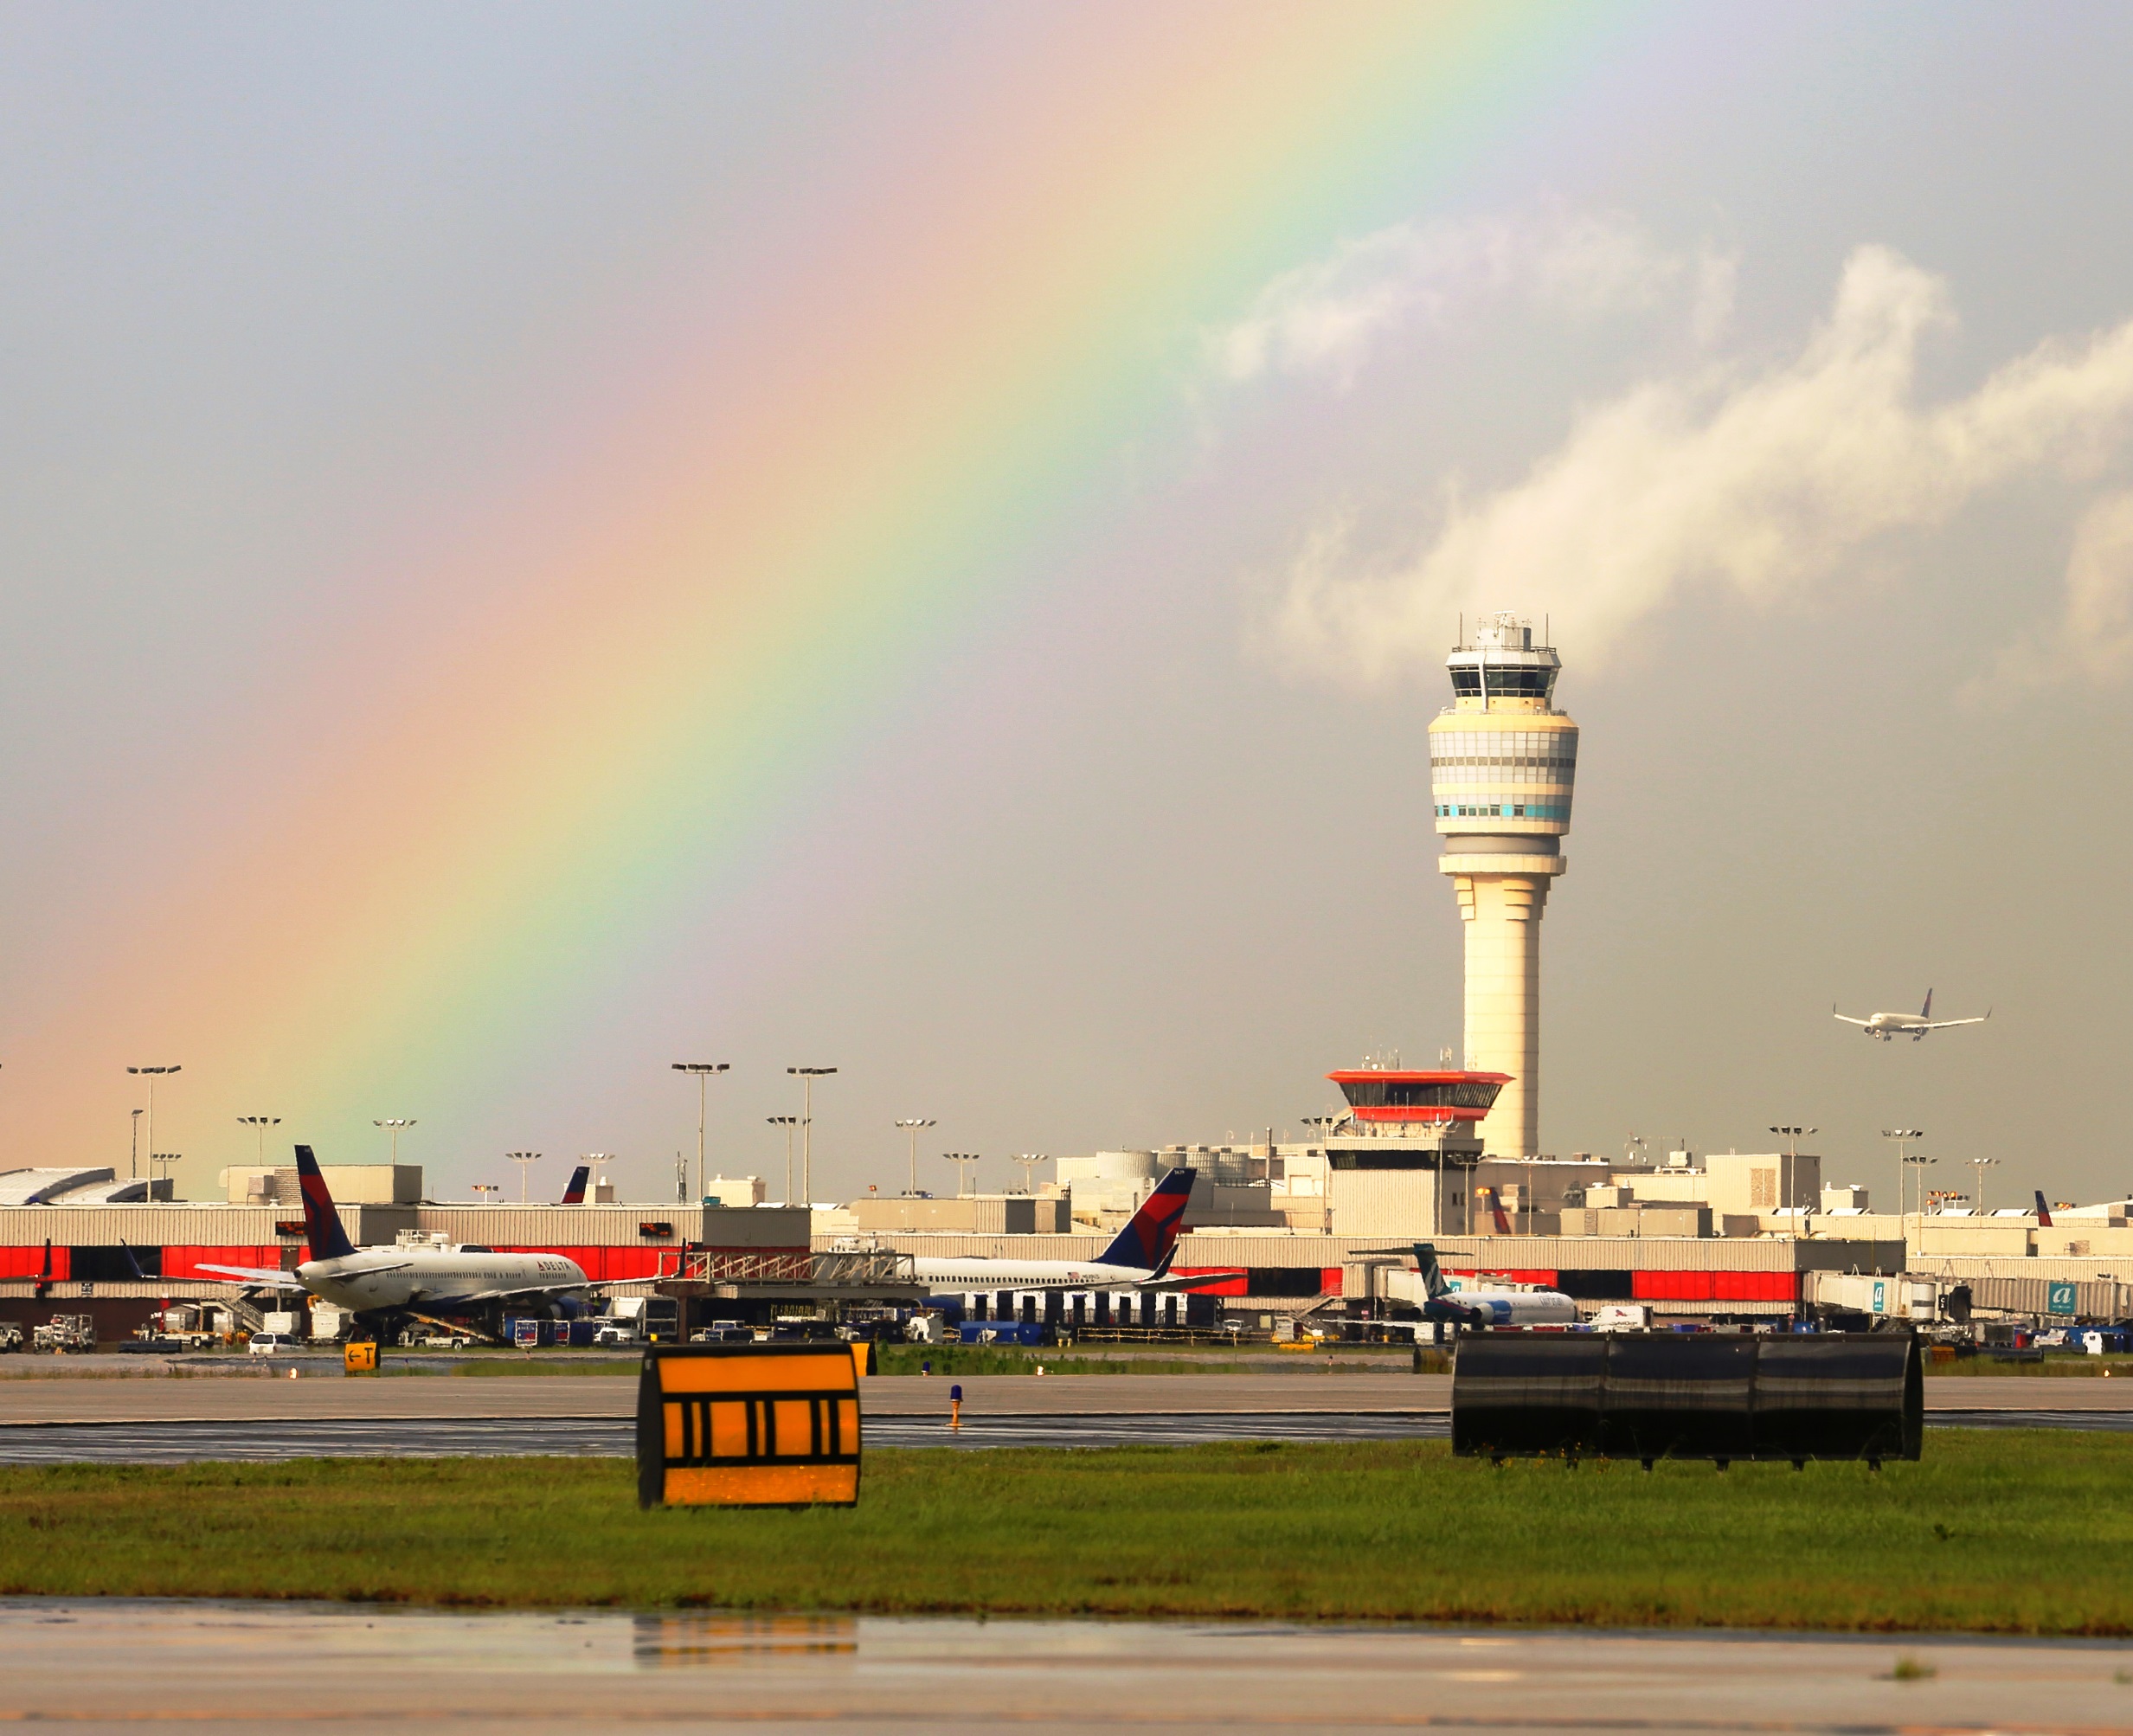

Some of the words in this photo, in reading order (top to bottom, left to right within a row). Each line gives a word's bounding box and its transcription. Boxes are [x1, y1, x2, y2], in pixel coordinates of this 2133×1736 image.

[543, 1261, 571, 1271] DELTA
[2053, 1287, 2071, 1303] a
[364, 1347, 373, 1364] T
